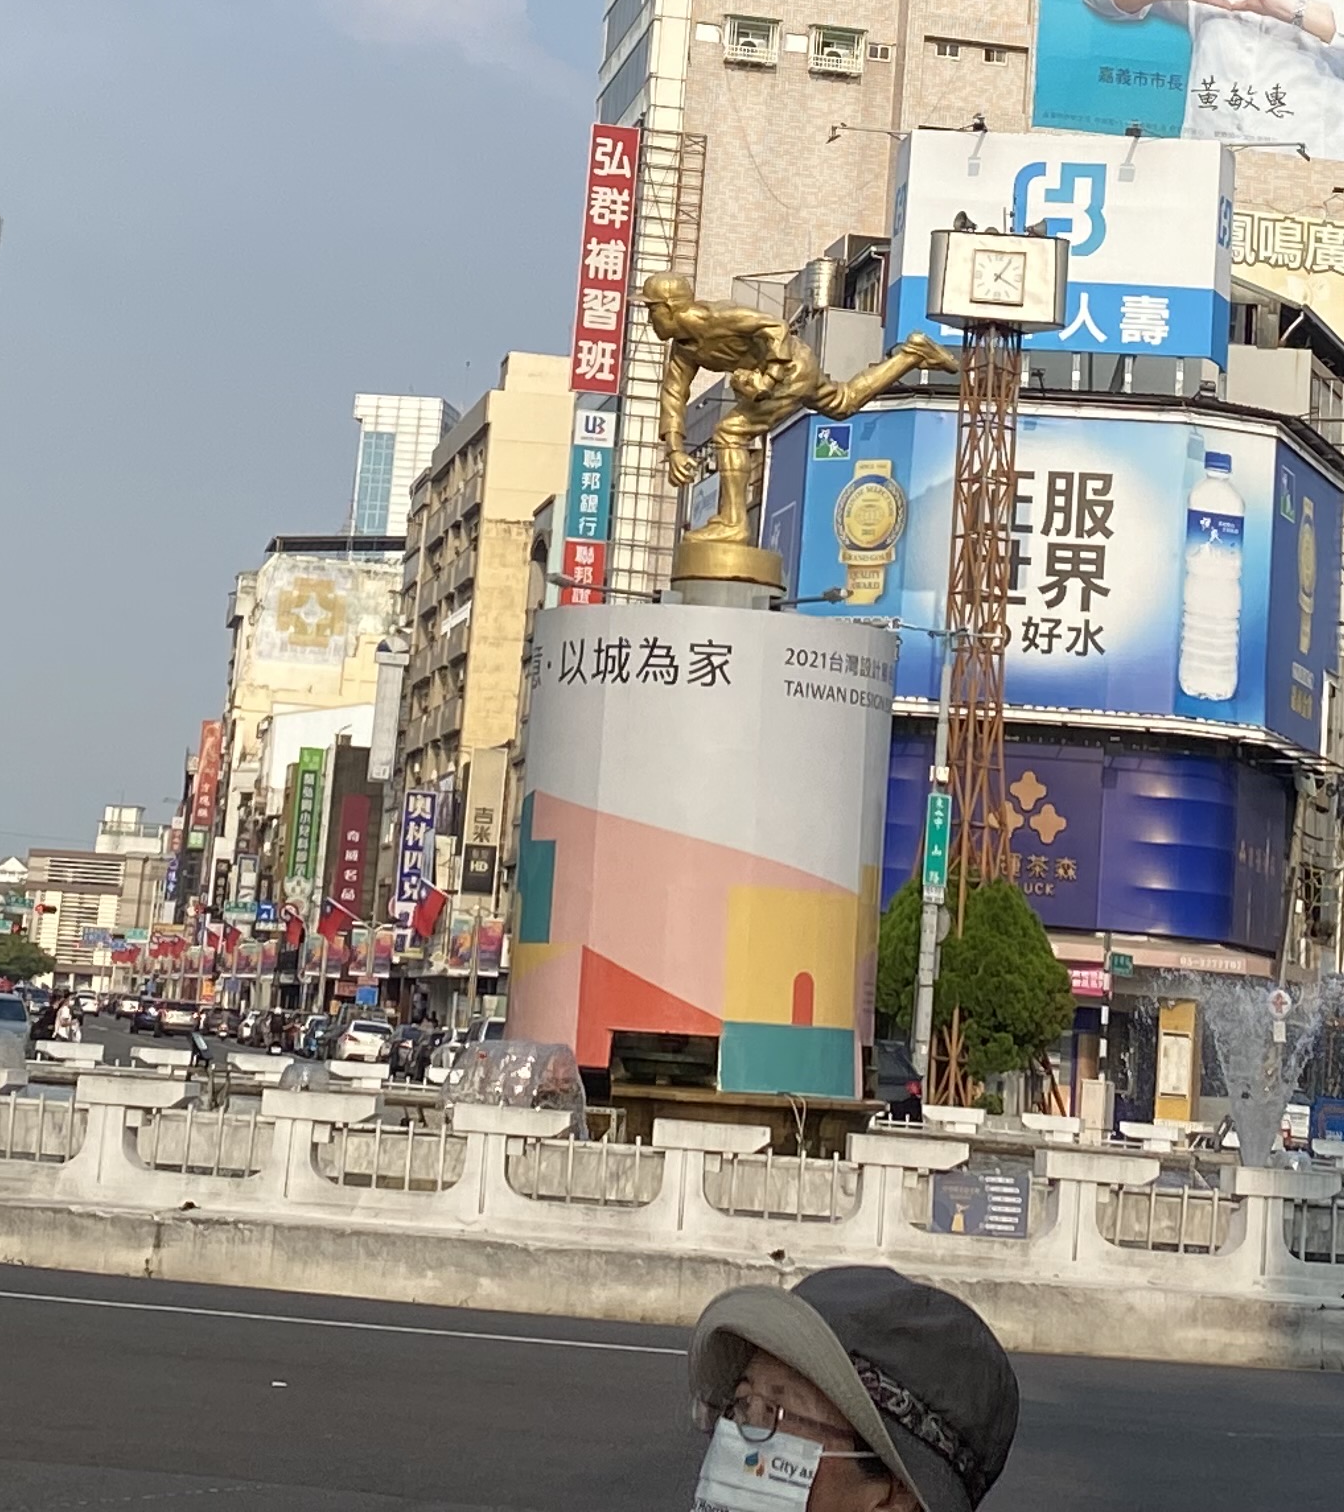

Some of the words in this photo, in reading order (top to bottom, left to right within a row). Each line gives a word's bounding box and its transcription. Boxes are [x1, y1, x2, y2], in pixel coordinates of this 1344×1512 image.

[1098, 65, 1184, 91] 嘉義市市長
[575, 136, 633, 383] 弘群補習班
[578, 449, 603, 537] 聯邦銀行
[784, 679, 848, 705] TAIWAN
[770, 1455, 799, 1476] City
